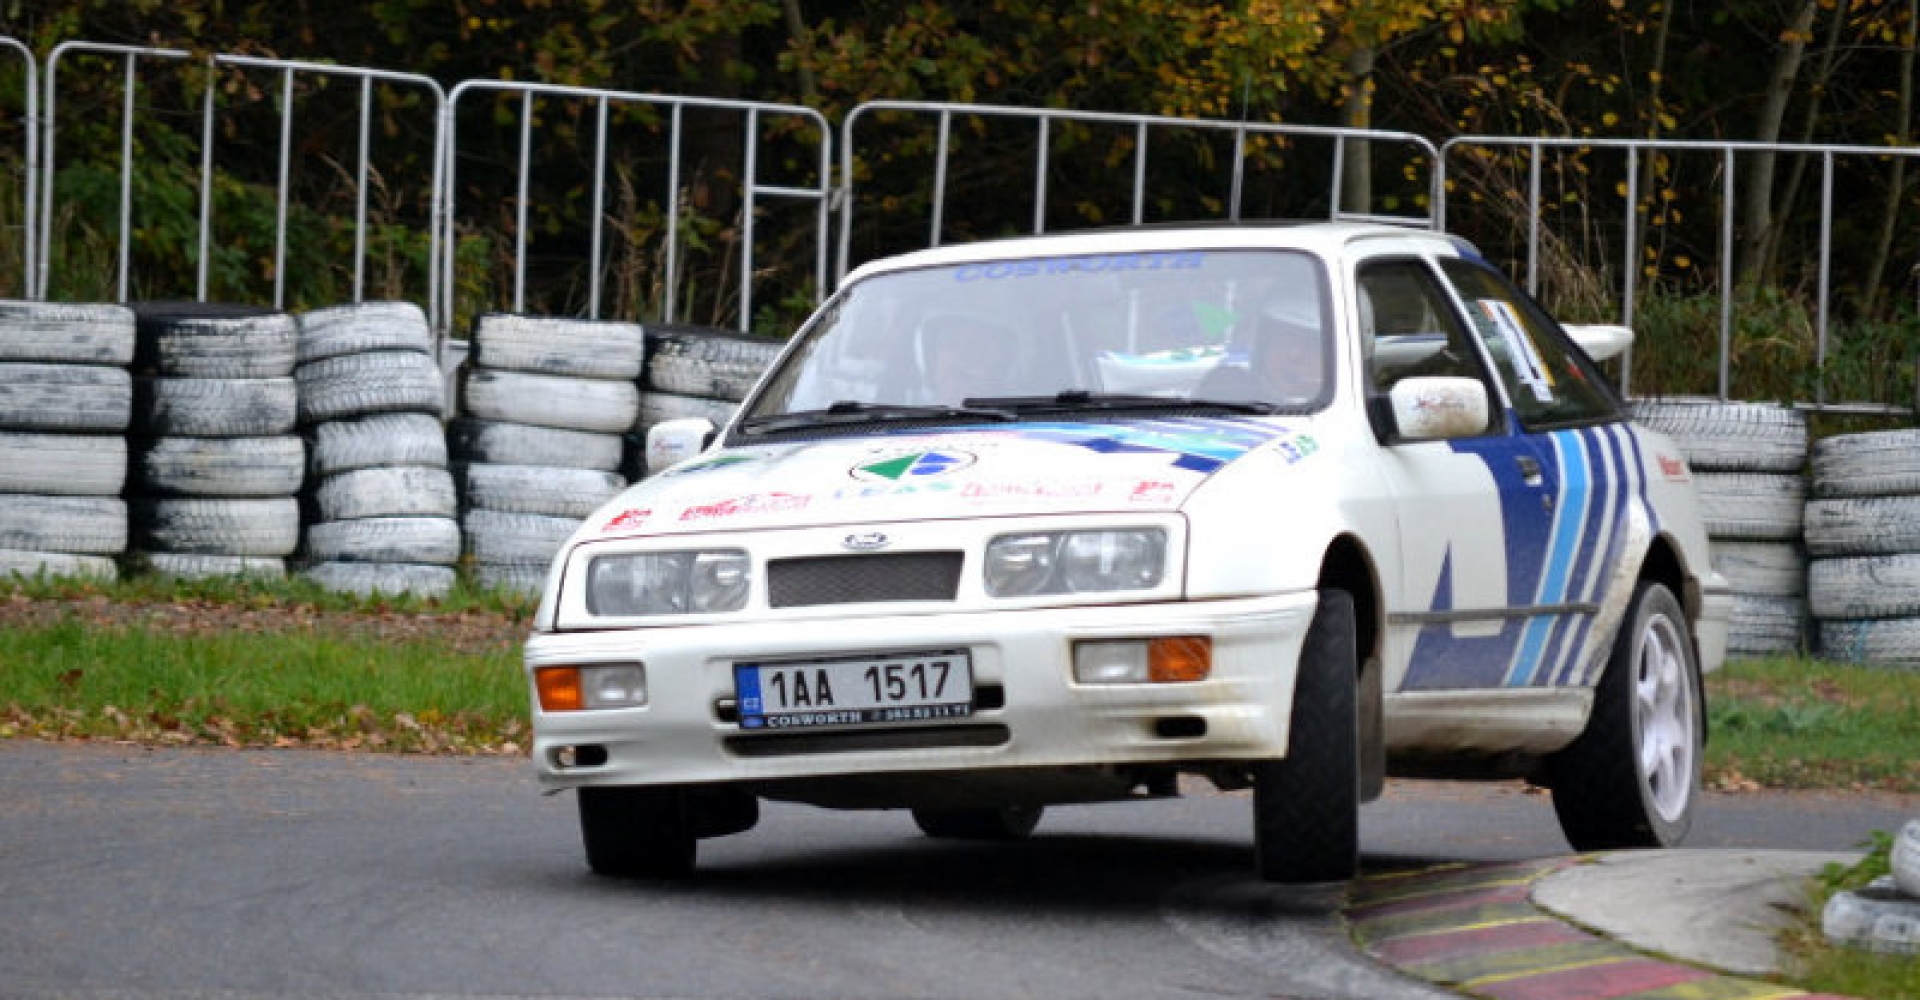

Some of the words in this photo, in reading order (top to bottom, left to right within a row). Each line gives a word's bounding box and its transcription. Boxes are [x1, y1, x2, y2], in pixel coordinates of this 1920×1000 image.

[771, 668, 834, 707] 1AA
[865, 661, 951, 703] 1517
[766, 710, 862, 728] COSWORTH
